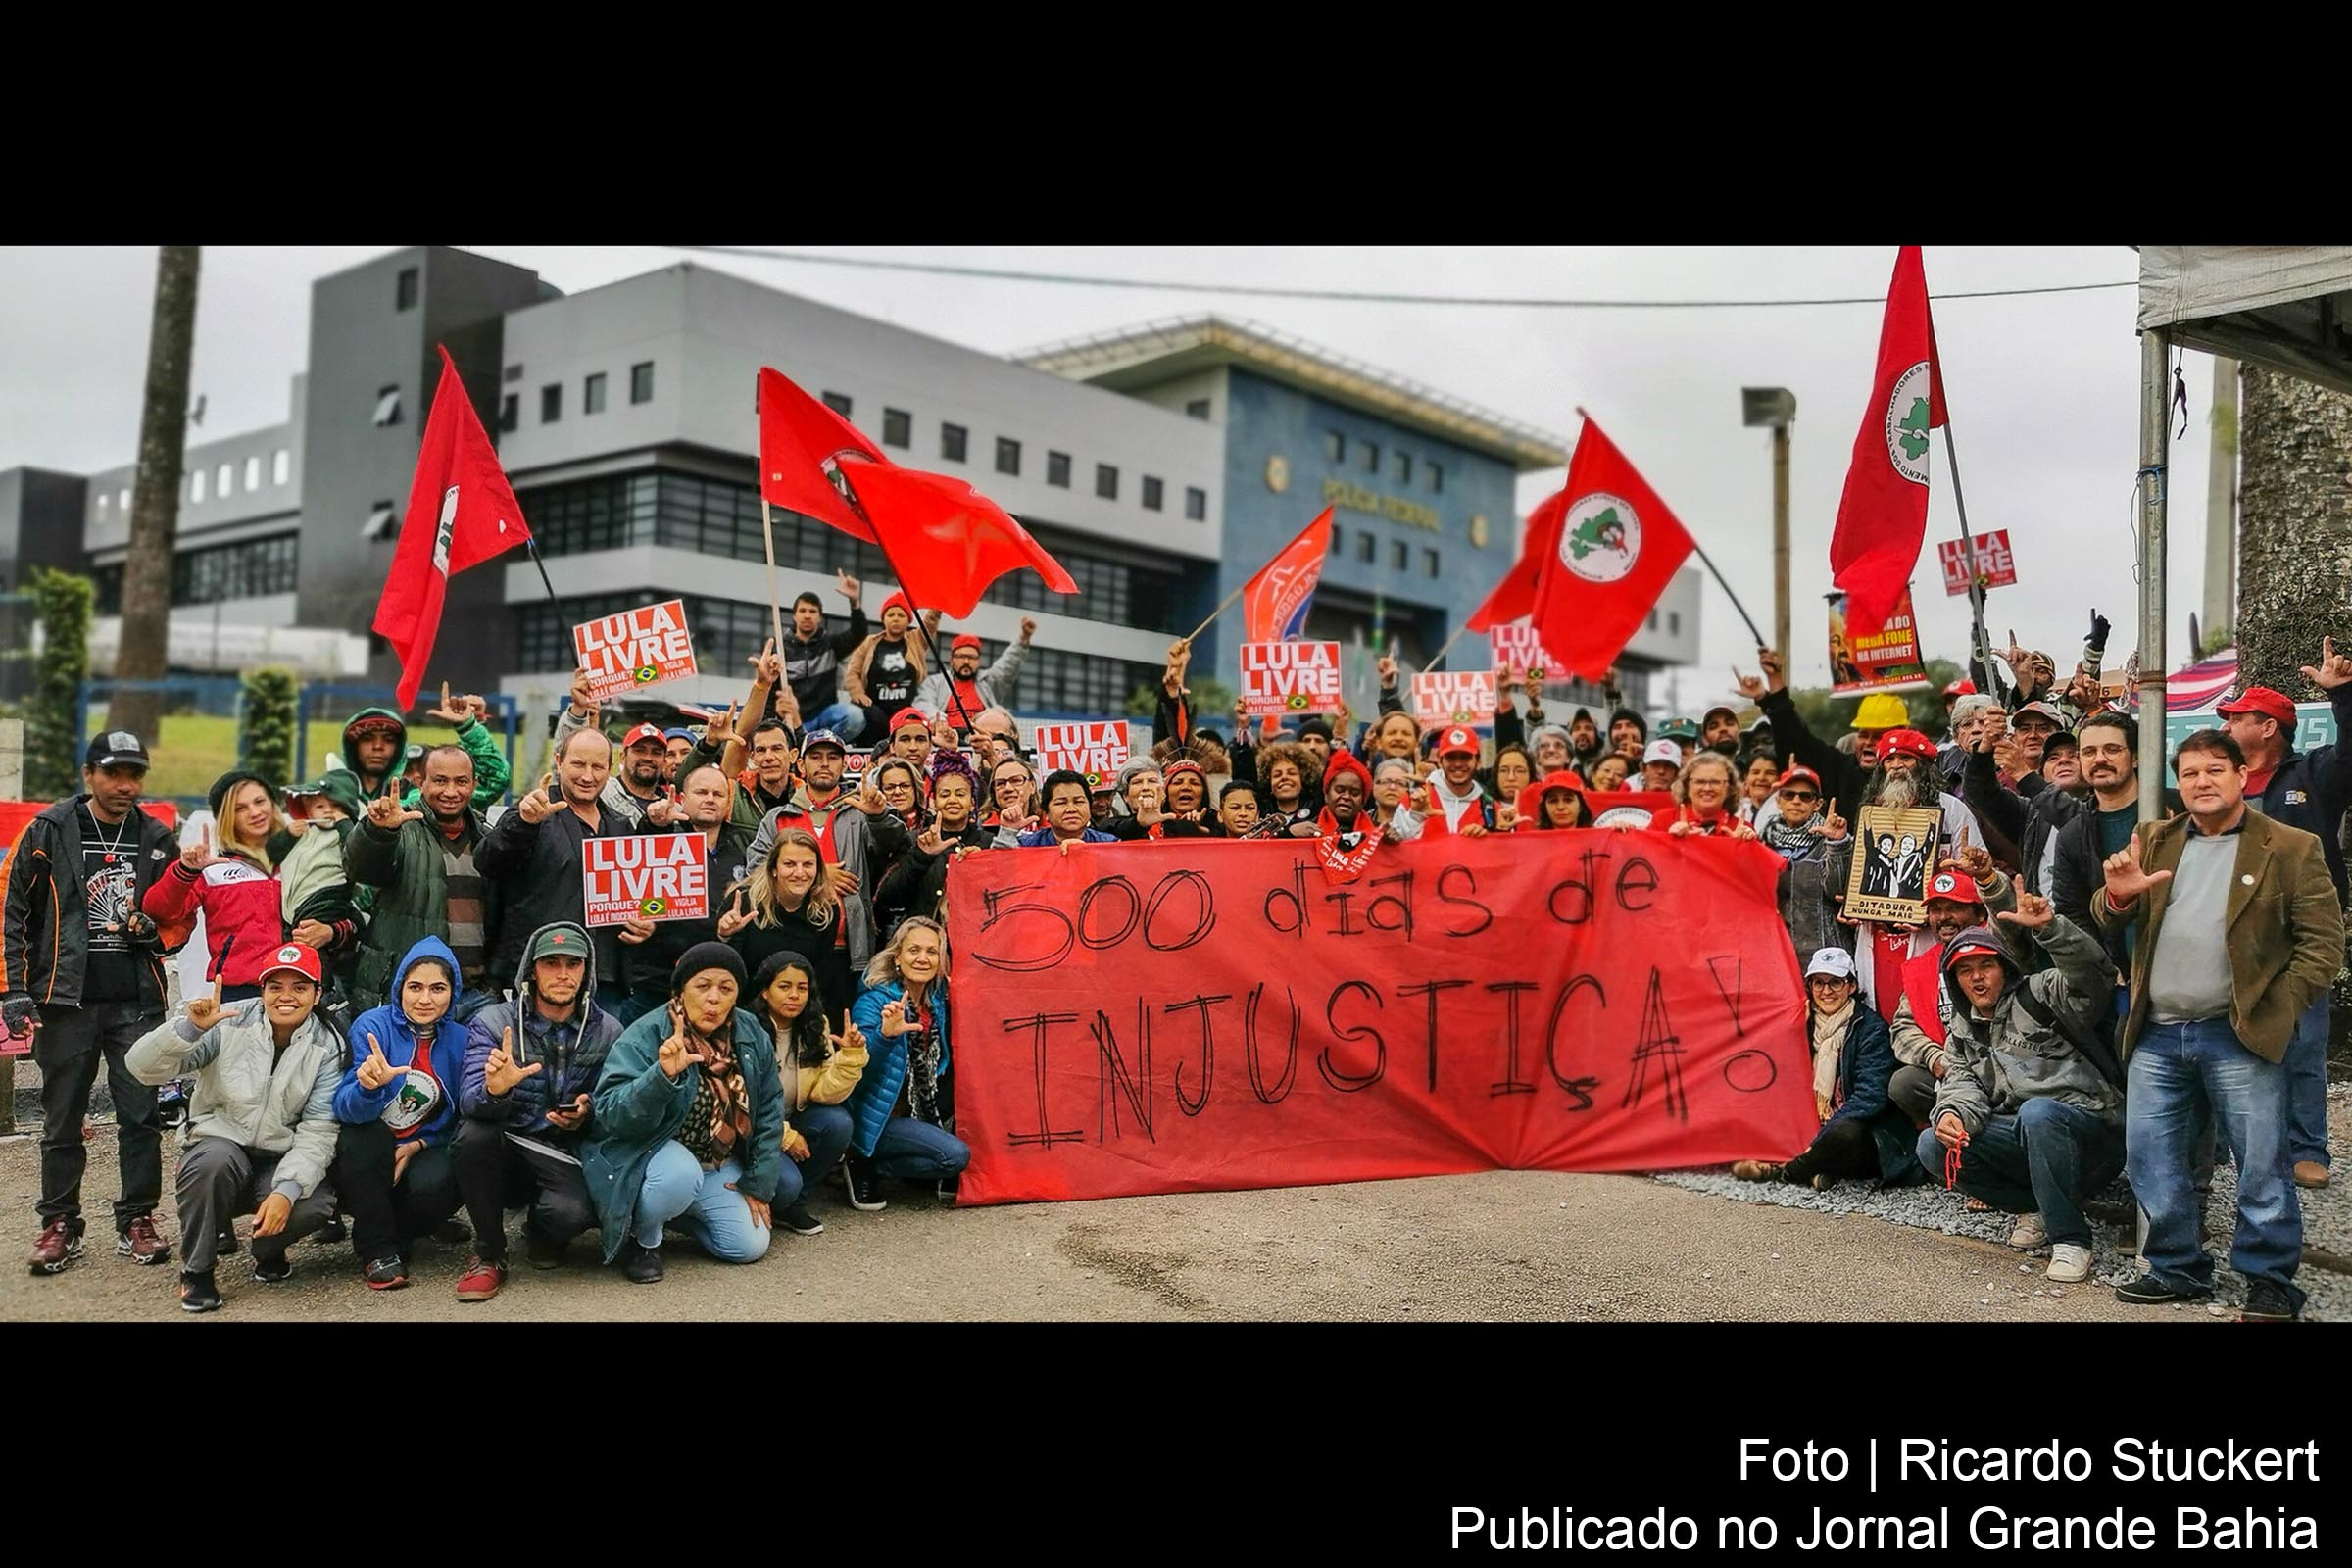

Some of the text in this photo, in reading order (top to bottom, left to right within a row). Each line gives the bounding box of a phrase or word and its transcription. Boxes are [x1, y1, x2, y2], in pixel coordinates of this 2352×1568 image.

[1943, 533, 2004, 562] LULA
[582, 605, 677, 651] LULA
[1495, 626, 1540, 649] LU
[1885, 629, 1914, 647] FONE
[581, 629, 691, 679] LIVRE
[1249, 643, 1333, 670] LULA
[1492, 647, 1564, 669] LIVR
[1857, 645, 1914, 663] NA INTERNET
[1244, 668, 1340, 696] LIVRE
[1419, 673, 1490, 694] LULA
[1416, 690, 1496, 713] LIVRE
[1044, 723, 1121, 751] LULA
[1041, 747, 1128, 777] LIVRE
[593, 835, 696, 871] LULA
[587, 865, 706, 903] LIVRE
[590, 899, 641, 913] PORQUE?
[972, 868, 1216, 972] 500
[1548, 848, 1660, 927] de
[1859, 900, 1913, 912] DITADURA
[1002, 955, 1777, 1150] INJUSTIÇA!
